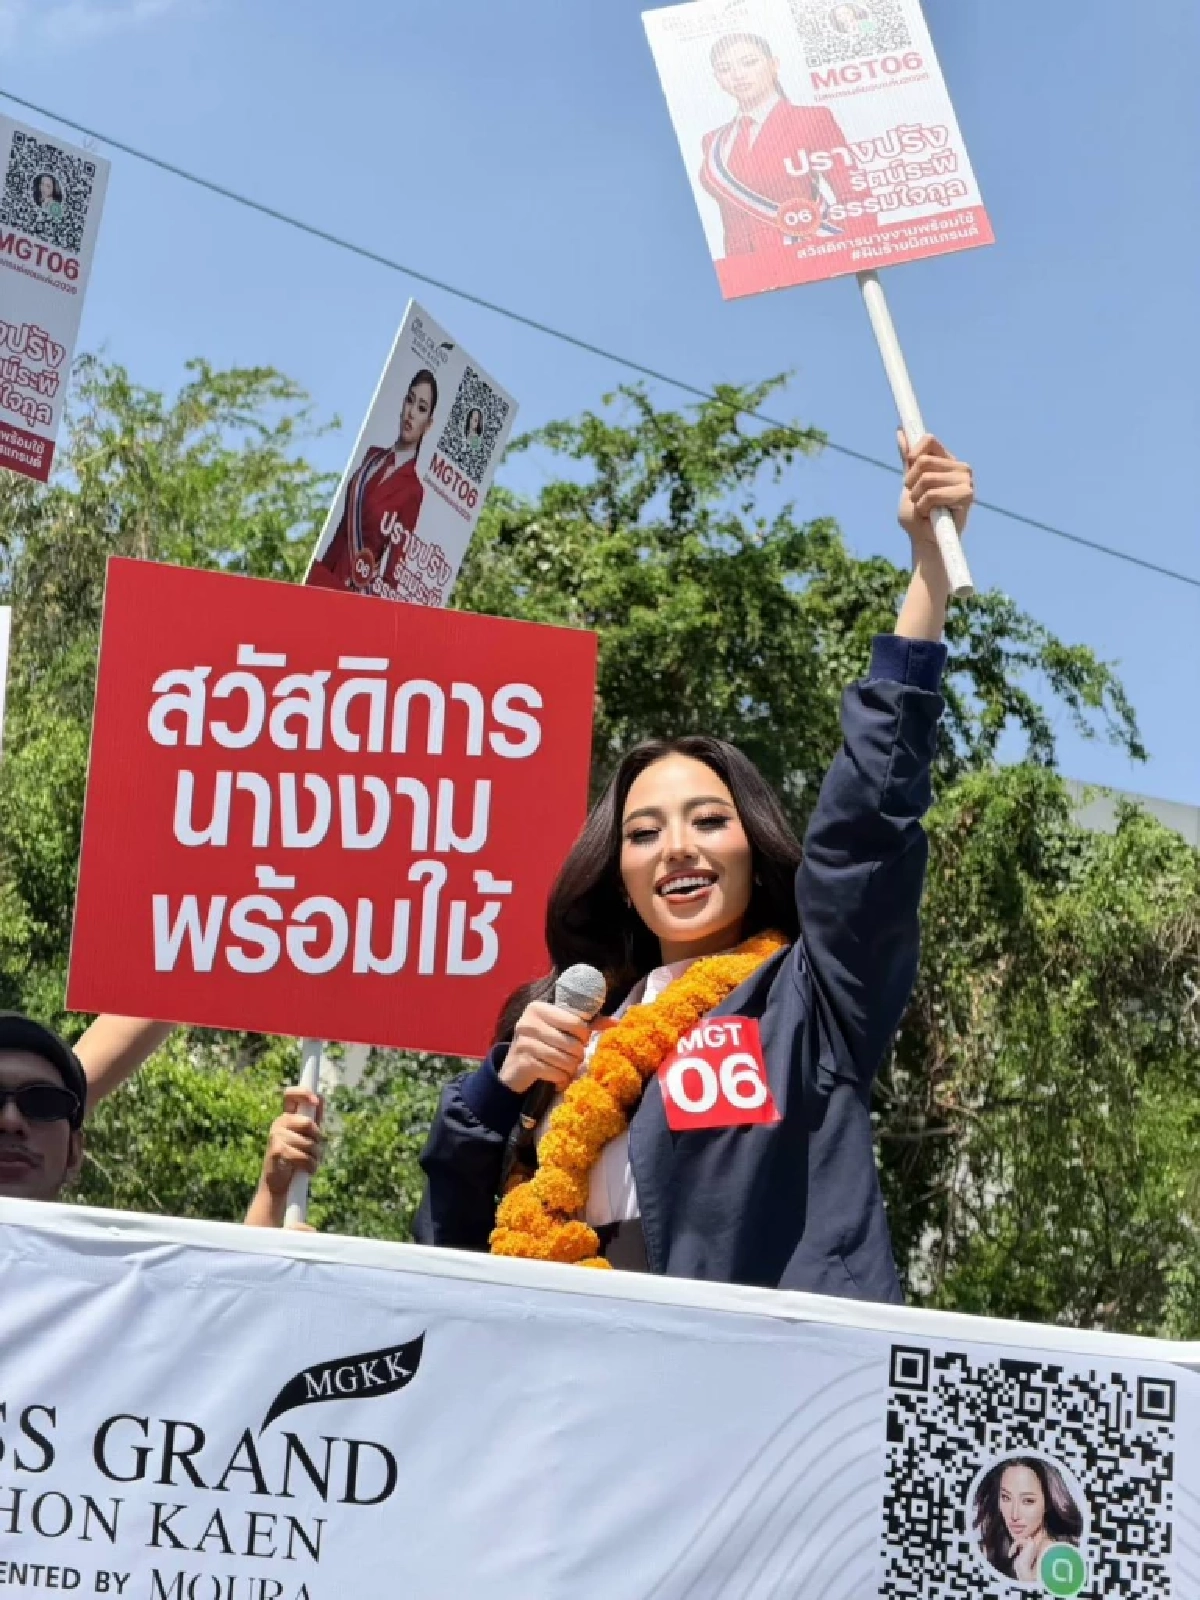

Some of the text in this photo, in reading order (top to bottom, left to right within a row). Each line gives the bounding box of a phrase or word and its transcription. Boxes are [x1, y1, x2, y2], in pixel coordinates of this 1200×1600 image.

[809, 51, 923, 91] MGT06
[784, 208, 813, 226] 06
[0, 228, 80, 281] MGT06
[428, 452, 479, 509] MGT06
[147, 644, 544, 758] สวัสดิการ
[173, 769, 492, 853] นางงาม
[151, 859, 513, 976] พร้อมใช้
[677, 1022, 742, 1053] MGT
[667, 1053, 767, 1113] 06
[303, 1352, 412, 1399] MGKK
[93, 1413, 398, 1505] GRAND
[145, 1501, 328, 1563] KAEN
[94, 1569, 131, 1595] BY
